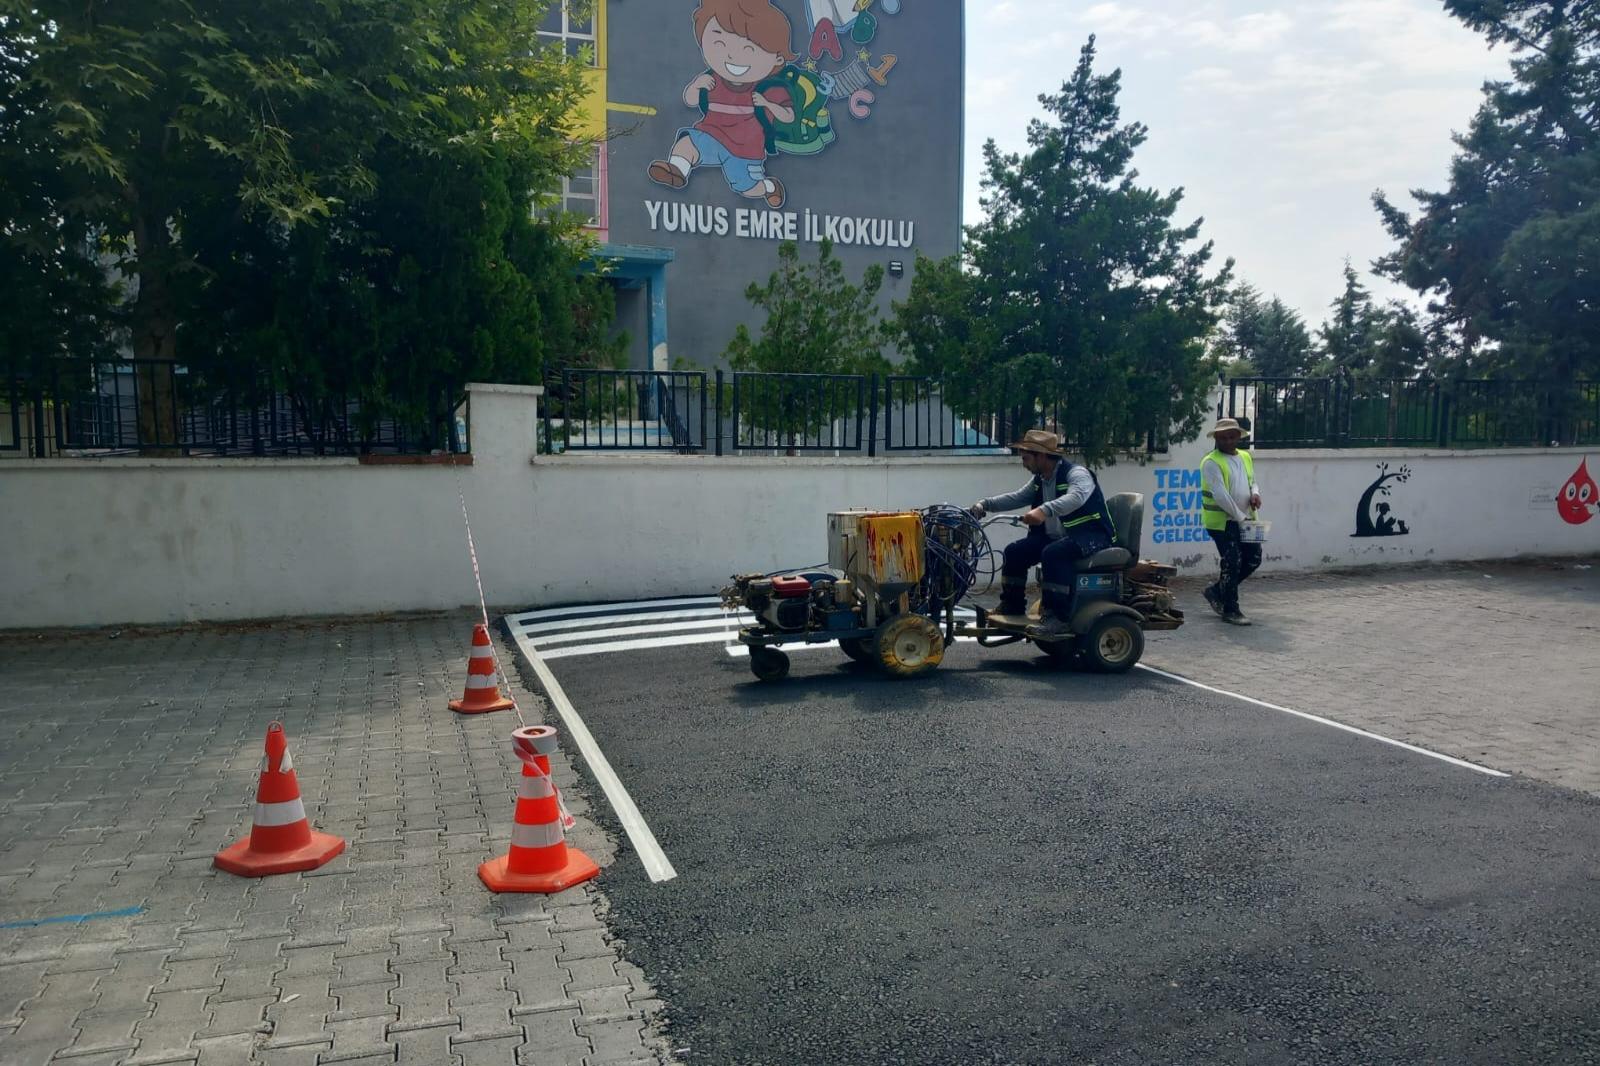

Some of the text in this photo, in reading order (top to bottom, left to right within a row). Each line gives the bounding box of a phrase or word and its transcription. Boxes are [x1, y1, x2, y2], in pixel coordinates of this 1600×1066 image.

[809, 17, 843, 62] A
[849, 89, 875, 118] C
[644, 200, 914, 248] YUNUS EMRE İLKOKULU
